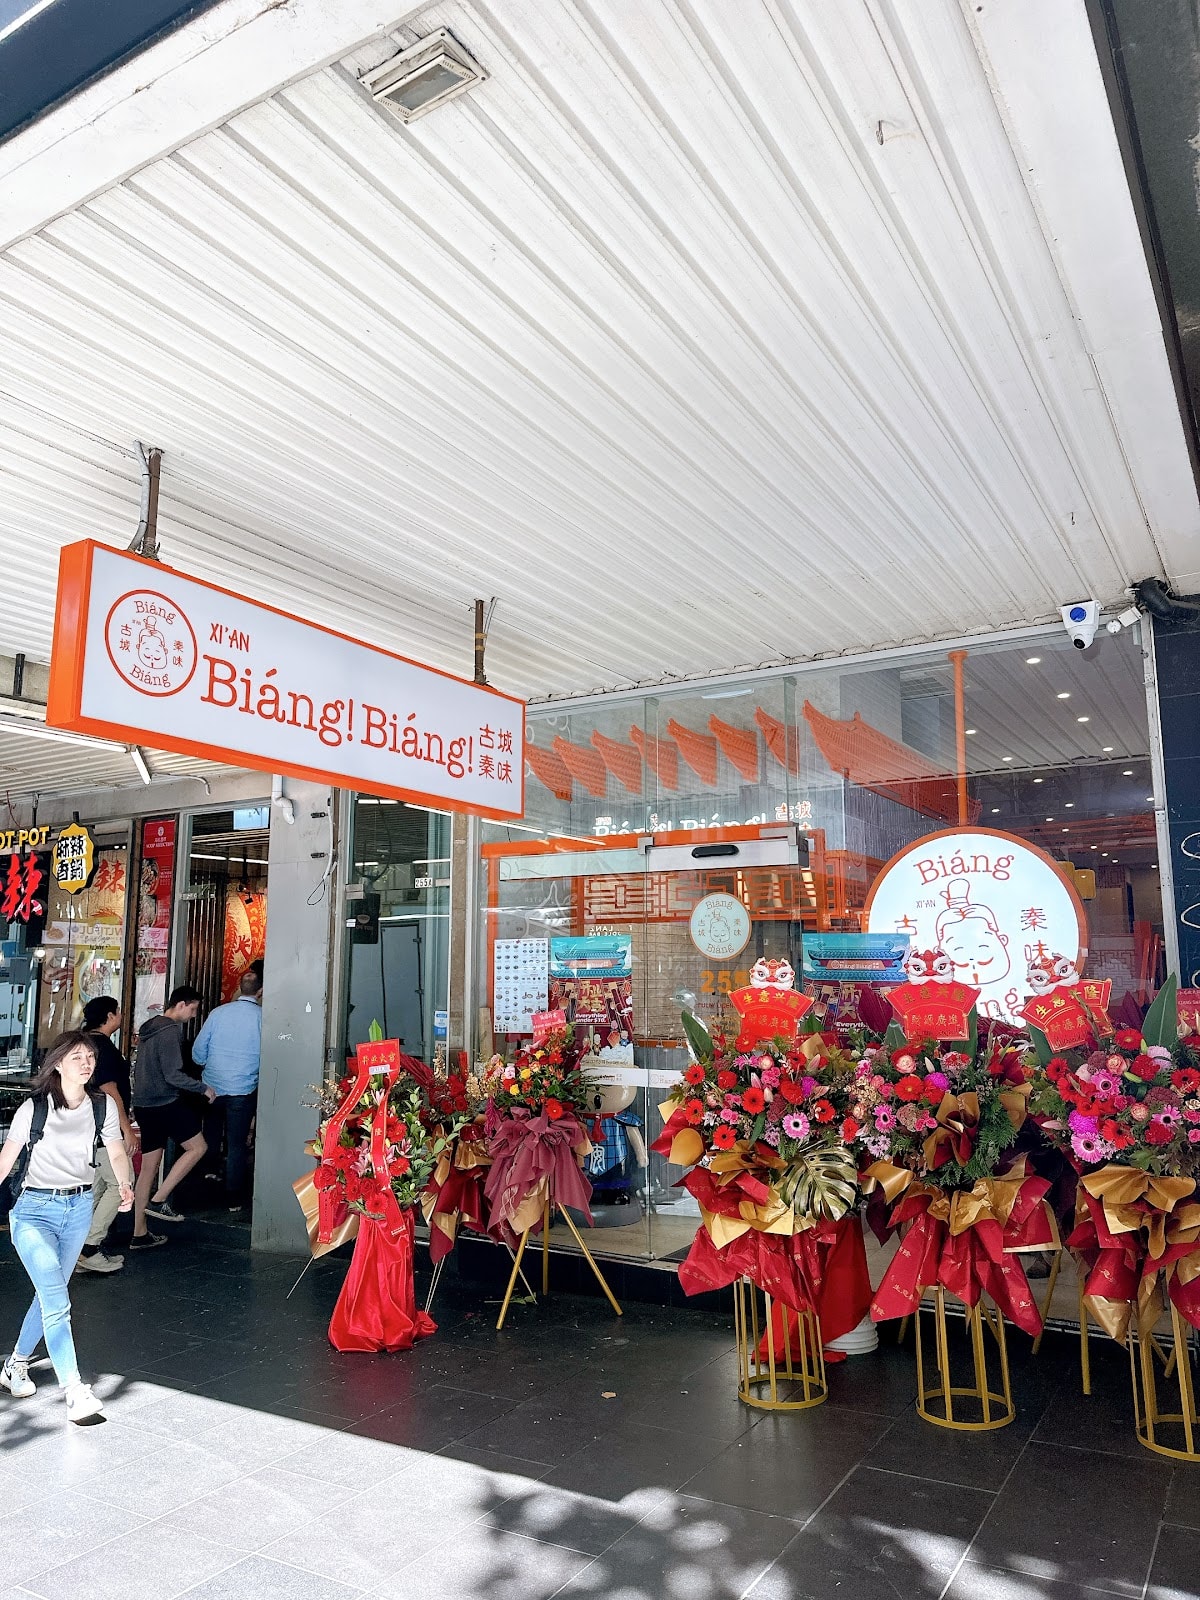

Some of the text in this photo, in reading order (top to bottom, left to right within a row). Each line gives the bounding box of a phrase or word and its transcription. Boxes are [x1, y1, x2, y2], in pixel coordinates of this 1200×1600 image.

[133, 600, 177, 625] Biáng
[209, 622, 250, 653] XI'AN
[129, 664, 172, 688] Biáng
[201, 654, 473, 779] Biáng! Biáng!
[479, 723, 513, 756] 古城
[478, 754, 513, 785] 秦味
[18, 826, 50, 847] POT
[912, 849, 1015, 886] Biáng
